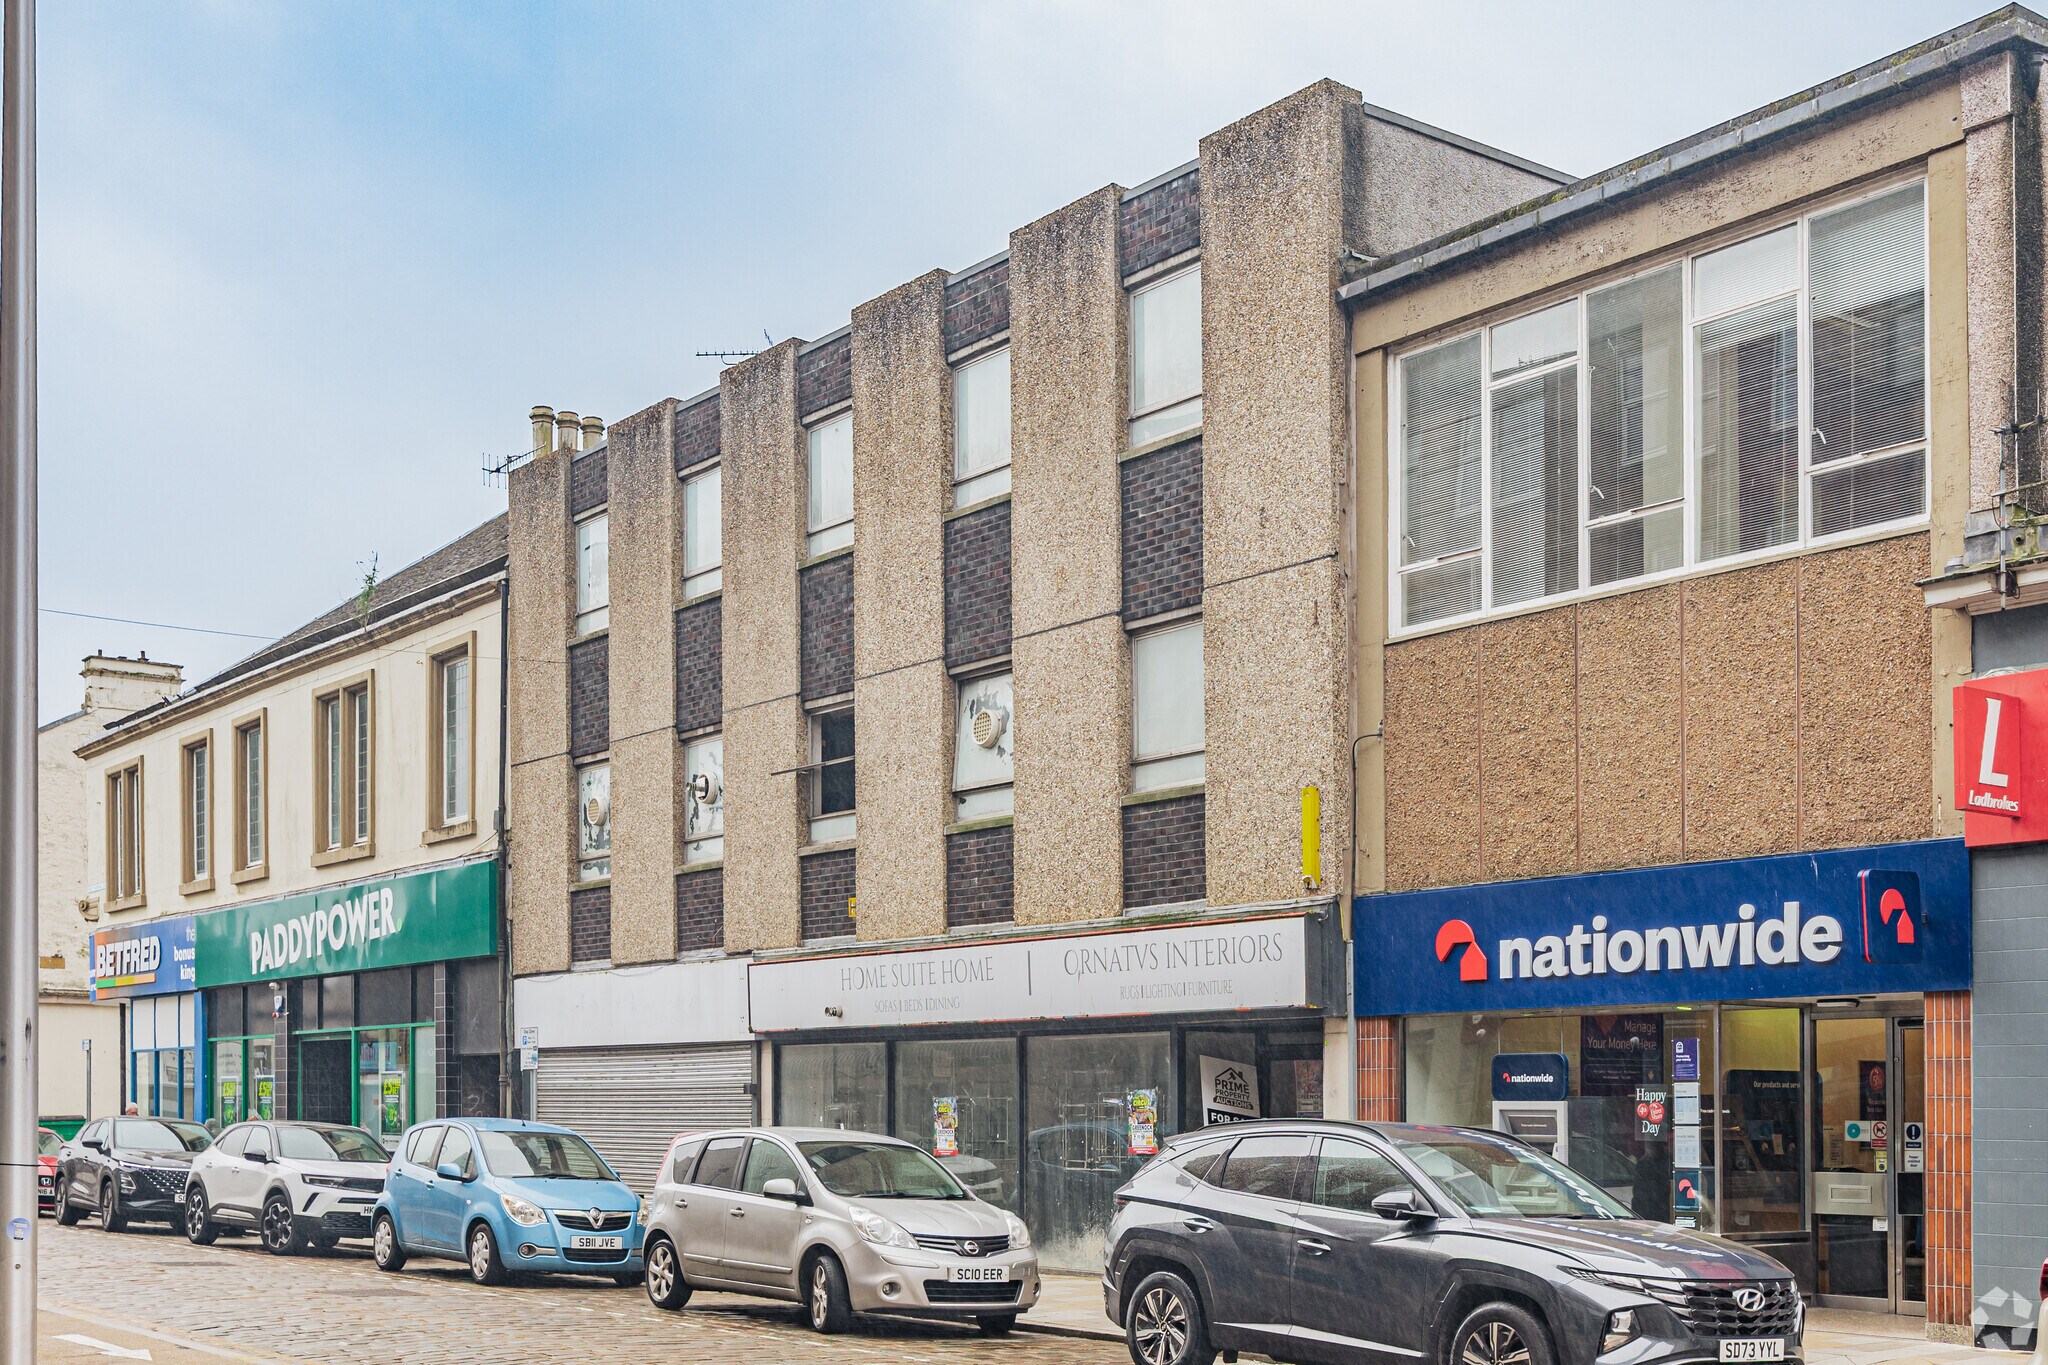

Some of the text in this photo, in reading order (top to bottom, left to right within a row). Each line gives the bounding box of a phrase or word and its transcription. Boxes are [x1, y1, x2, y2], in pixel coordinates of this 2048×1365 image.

[1979, 697, 2009, 788] L
[1968, 789, 2019, 812] Ladbrokes
[186, 926, 196, 942] the
[1499, 901, 1843, 980] nationwide
[96, 936, 161, 978] BETFRED
[174, 946, 196, 962] bonus
[1165, 932, 1283, 969] INTERIORS
[180, 964, 196, 983] king
[841, 956, 995, 991] HOME SUITE HOME
[1120, 979, 1233, 1000] RUGS LIGHTING FURNITURE
[874, 997, 961, 1014] SOFAS BEDS DINING
[1624, 1020, 1657, 1036] Manage
[1587, 1035, 1657, 1053] Your Money Here
[1511, 1073, 1554, 1083] nationwide
[1762, 1081, 1781, 1089] products
[1214, 1079, 1250, 1095] PRIME
[1215, 1088, 1250, 1101] PROPERTY
[1216, 1095, 1251, 1109] AUCTIONS
[1636, 1088, 1667, 1105] Happy
[1211, 1112, 1230, 1123] FOR
[1641, 1120, 1661, 1137] Day
[364, 1206, 375, 1215] HK
[579, 1237, 616, 1248] SB11 JVE
[957, 1268, 1003, 1280] SC10 EER
[1725, 1341, 1780, 1359] SD73 YYL
